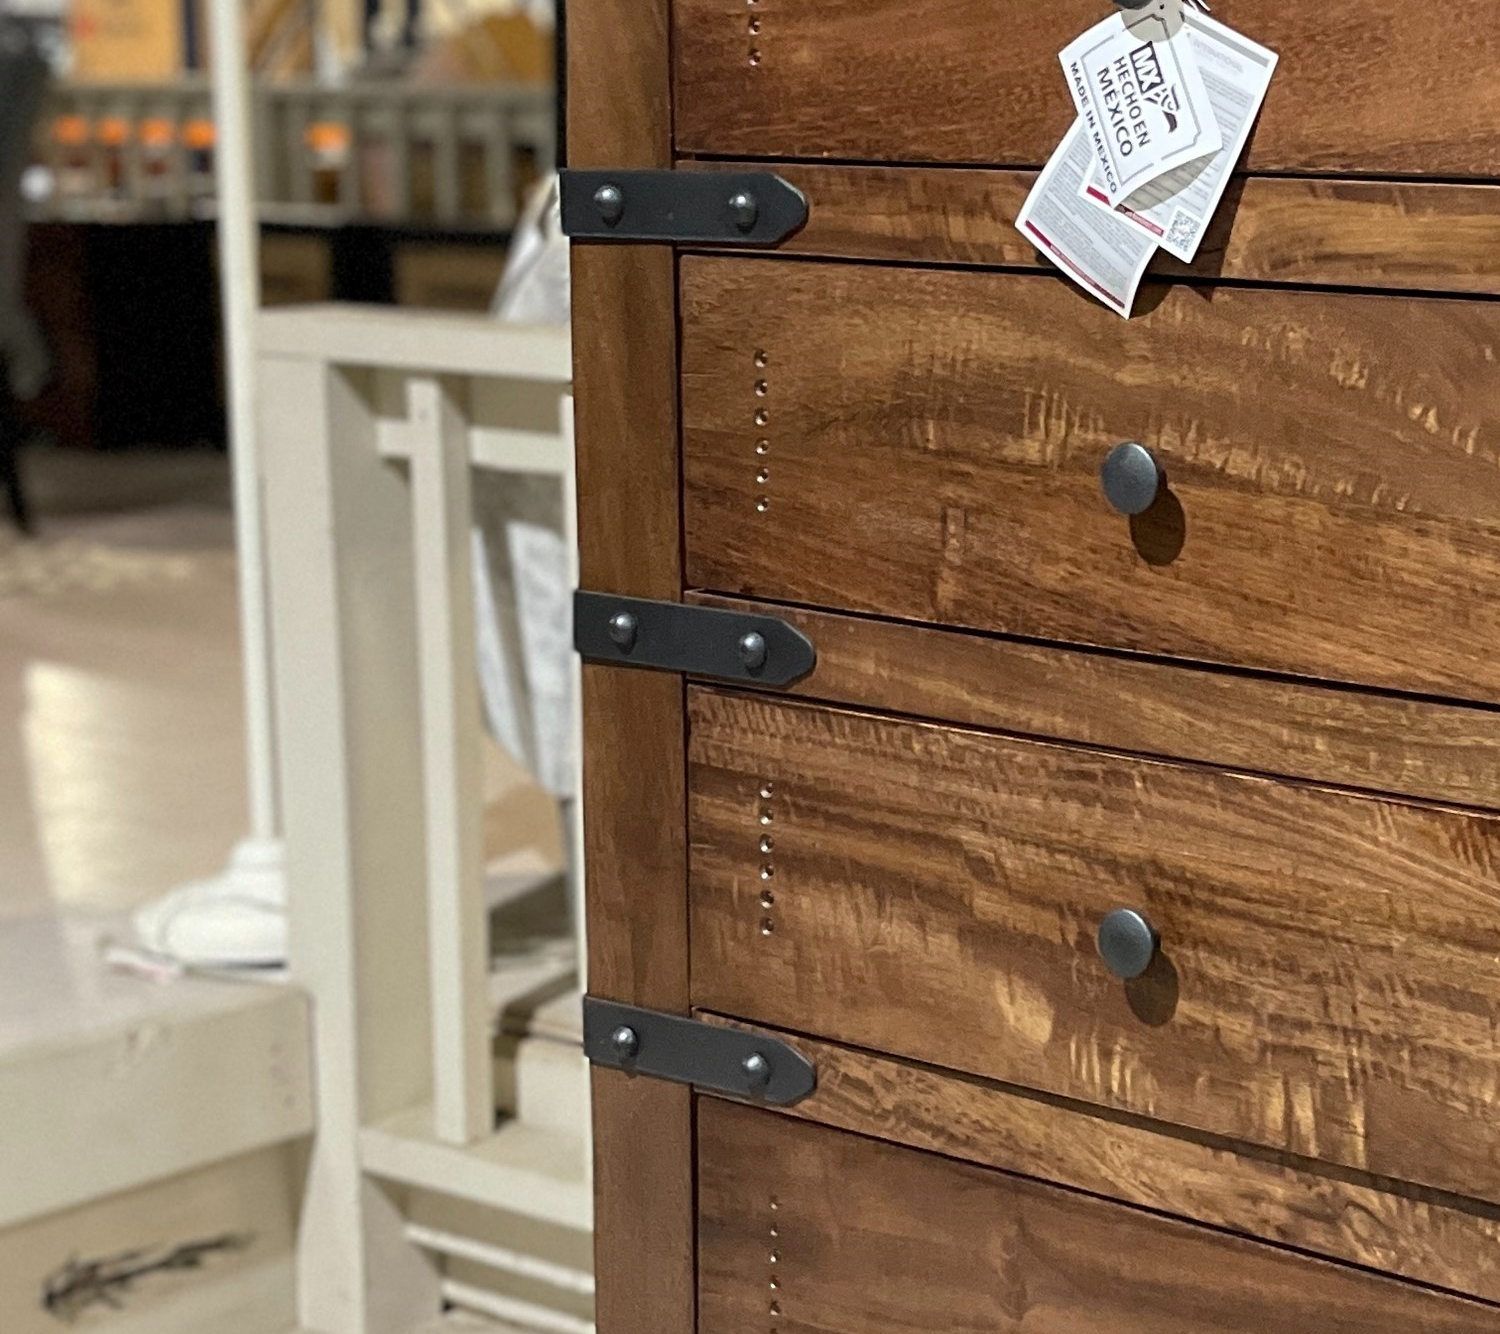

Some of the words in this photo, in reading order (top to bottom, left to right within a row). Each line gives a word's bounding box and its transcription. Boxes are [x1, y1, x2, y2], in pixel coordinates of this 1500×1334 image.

[1070, 62, 1089, 108] MADE
[1085, 110, 1097, 129] IN
[1093, 131, 1117, 194] MEXICO
[1097, 67, 1133, 157] MÉXICO
[1113, 56, 1142, 121] HECHO
[1133, 120, 1150, 150] EN
